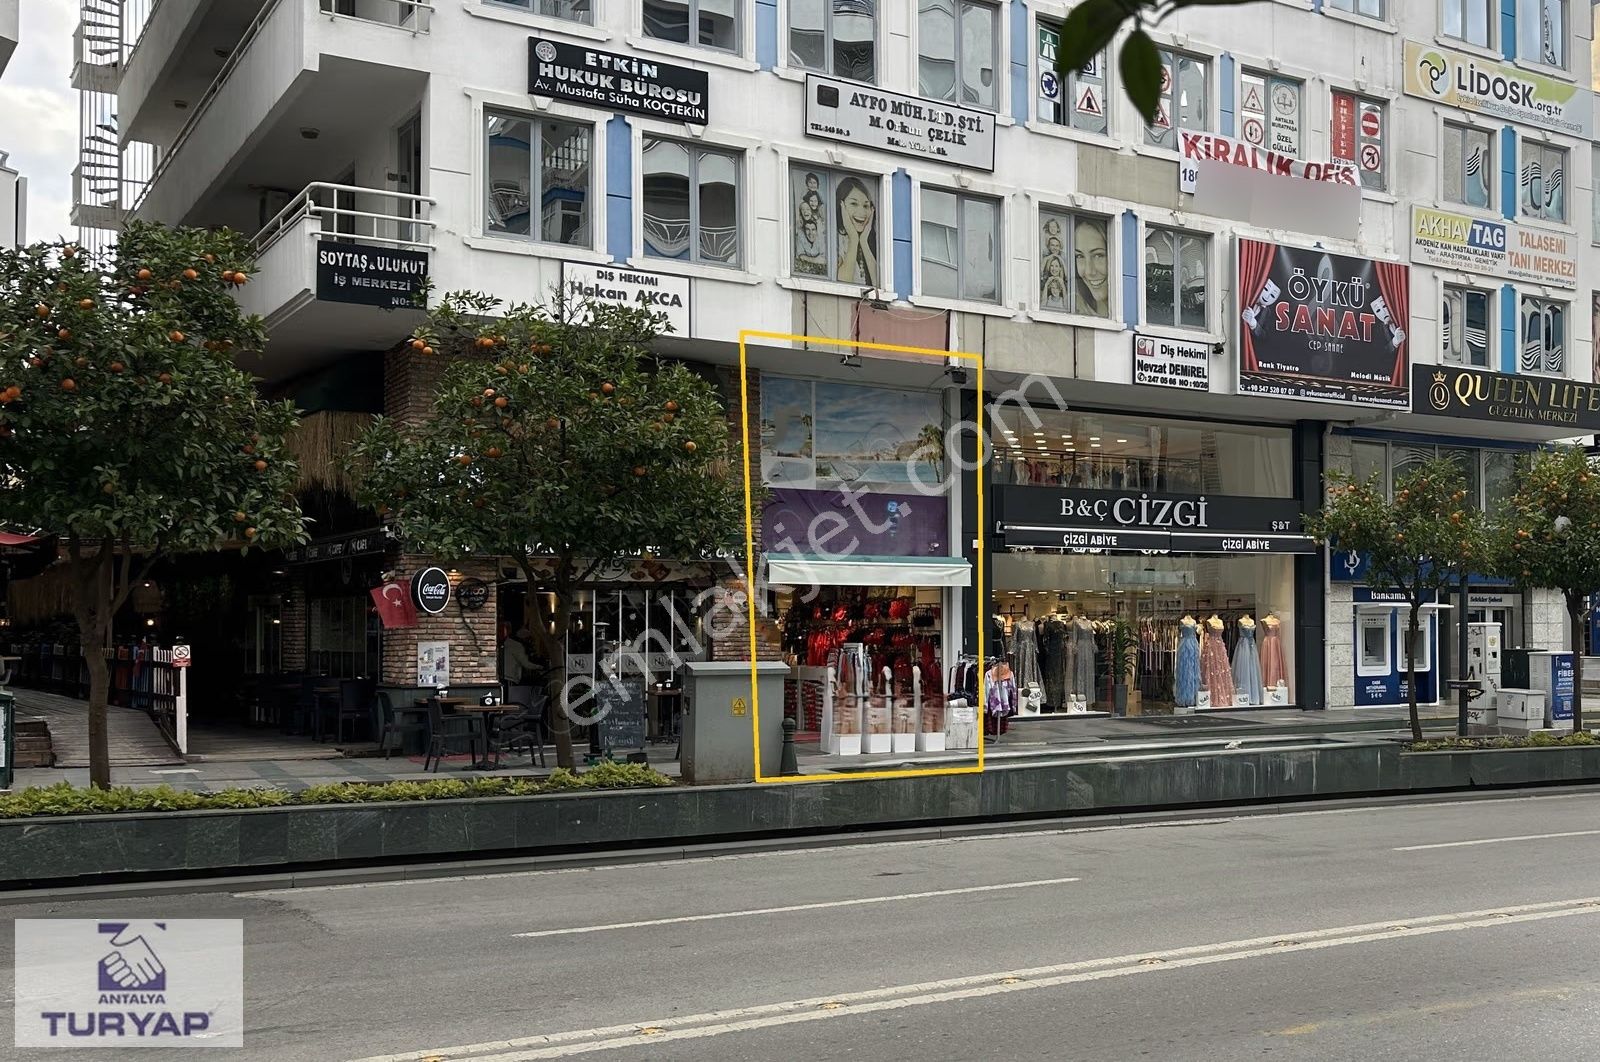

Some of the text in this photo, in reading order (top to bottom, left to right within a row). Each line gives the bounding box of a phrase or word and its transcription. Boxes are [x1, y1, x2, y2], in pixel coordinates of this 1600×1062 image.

[585, 52, 658, 79] ETKİN
[539, 63, 701, 106] HUKUK BÜROSU
[534, 78, 706, 120] Av. Mustafa Süha KOÇTEKİN
[850, 92, 888, 112] AYFO
[869, 115, 884, 129] M.
[928, 128, 967, 146] ÇELİK
[1276, 132, 1292, 144] ÖZEL
[1272, 143, 1297, 155] GÜLLÜK
[1415, 238, 1439, 249] AKDENİZ
[1440, 241, 1451, 251] KAN
[1519, 230, 1566, 255] TALASEMİ
[320, 250, 368, 272] SOYTAŞ
[377, 256, 426, 275] ULUKUT
[1507, 250, 1576, 278] TANI MERKEZİ
[333, 272, 411, 291] İŞ MERKEZİ
[1287, 267, 1365, 309] ÖYKÜ
[571, 281, 683, 308] Hakan AKCA
[1275, 301, 1376, 342] SANAT
[1160, 344, 1206, 360] Diş Hekimi
[1308, 340, 1322, 350] CEP
[1137, 359, 1207, 379] Nevzat DEMİREL
[1258, 361, 1300, 372] Renk Tiyatro
[1351, 371, 1372, 380] Melodi
[1454, 372, 1600, 412] QUEEN LIFE
[1488, 404, 1578, 424] GÜZELLİK MERKEZİ
[1060, 498, 1108, 521] B&Ç
[1272, 520, 1291, 532] Ş&T
[1063, 533, 1118, 547] ÇİZGİ ABİYE
[1222, 538, 1270, 550] ÇİZGİ ABİYE
